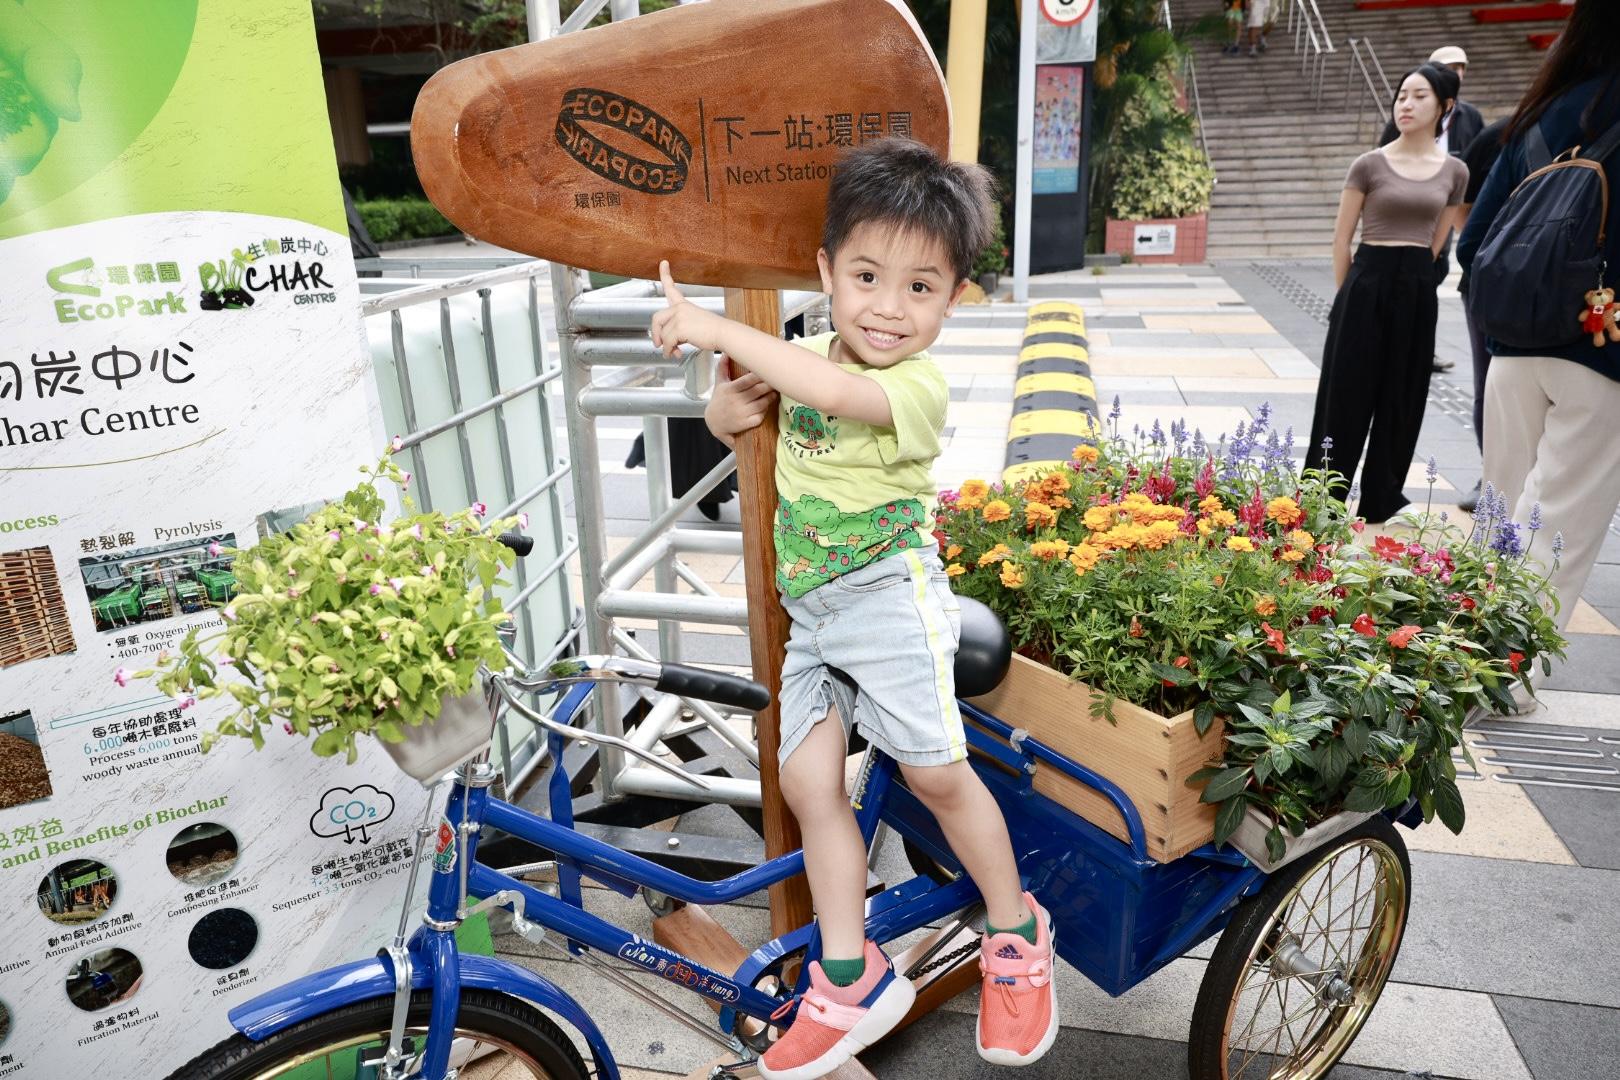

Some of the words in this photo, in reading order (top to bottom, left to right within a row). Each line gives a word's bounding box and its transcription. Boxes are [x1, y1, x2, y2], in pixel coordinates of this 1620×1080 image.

[572, 94, 684, 162] ECOPARK
[726, 165, 770, 186] Next
[574, 191, 621, 209] 環保園
[247, 236, 329, 261] 生物炭中心
[54, 291, 188, 323] EcoPark
[293, 292, 337, 305] CENTRE
[0, 417, 69, 447] har
[81, 402, 200, 436] Centre
[154, 518, 223, 541] Pyrolysis
[90, 748, 136, 767] Process
[173, 732, 198, 746] tons
[82, 762, 122, 783] woody
[126, 756, 160, 770] waste
[2, 846, 41, 869] and
[46, 824, 129, 857] Benefits
[133, 812, 153, 831] of
[156, 794, 229, 825] Biochar
[167, 896, 219, 918] Composting
[219, 882, 259, 902] Enhancer
[272, 889, 322, 913] Sequester
[341, 876, 363, 891] tons
[45, 940, 79, 959] Animal
[79, 935, 103, 948] Feed
[104, 921, 143, 940] Additive
[995, 951, 1023, 960] adidas
[212, 975, 259, 997] Deodorizer
[77, 1026, 120, 1048] Filtration
[122, 1011, 160, 1031] Material
